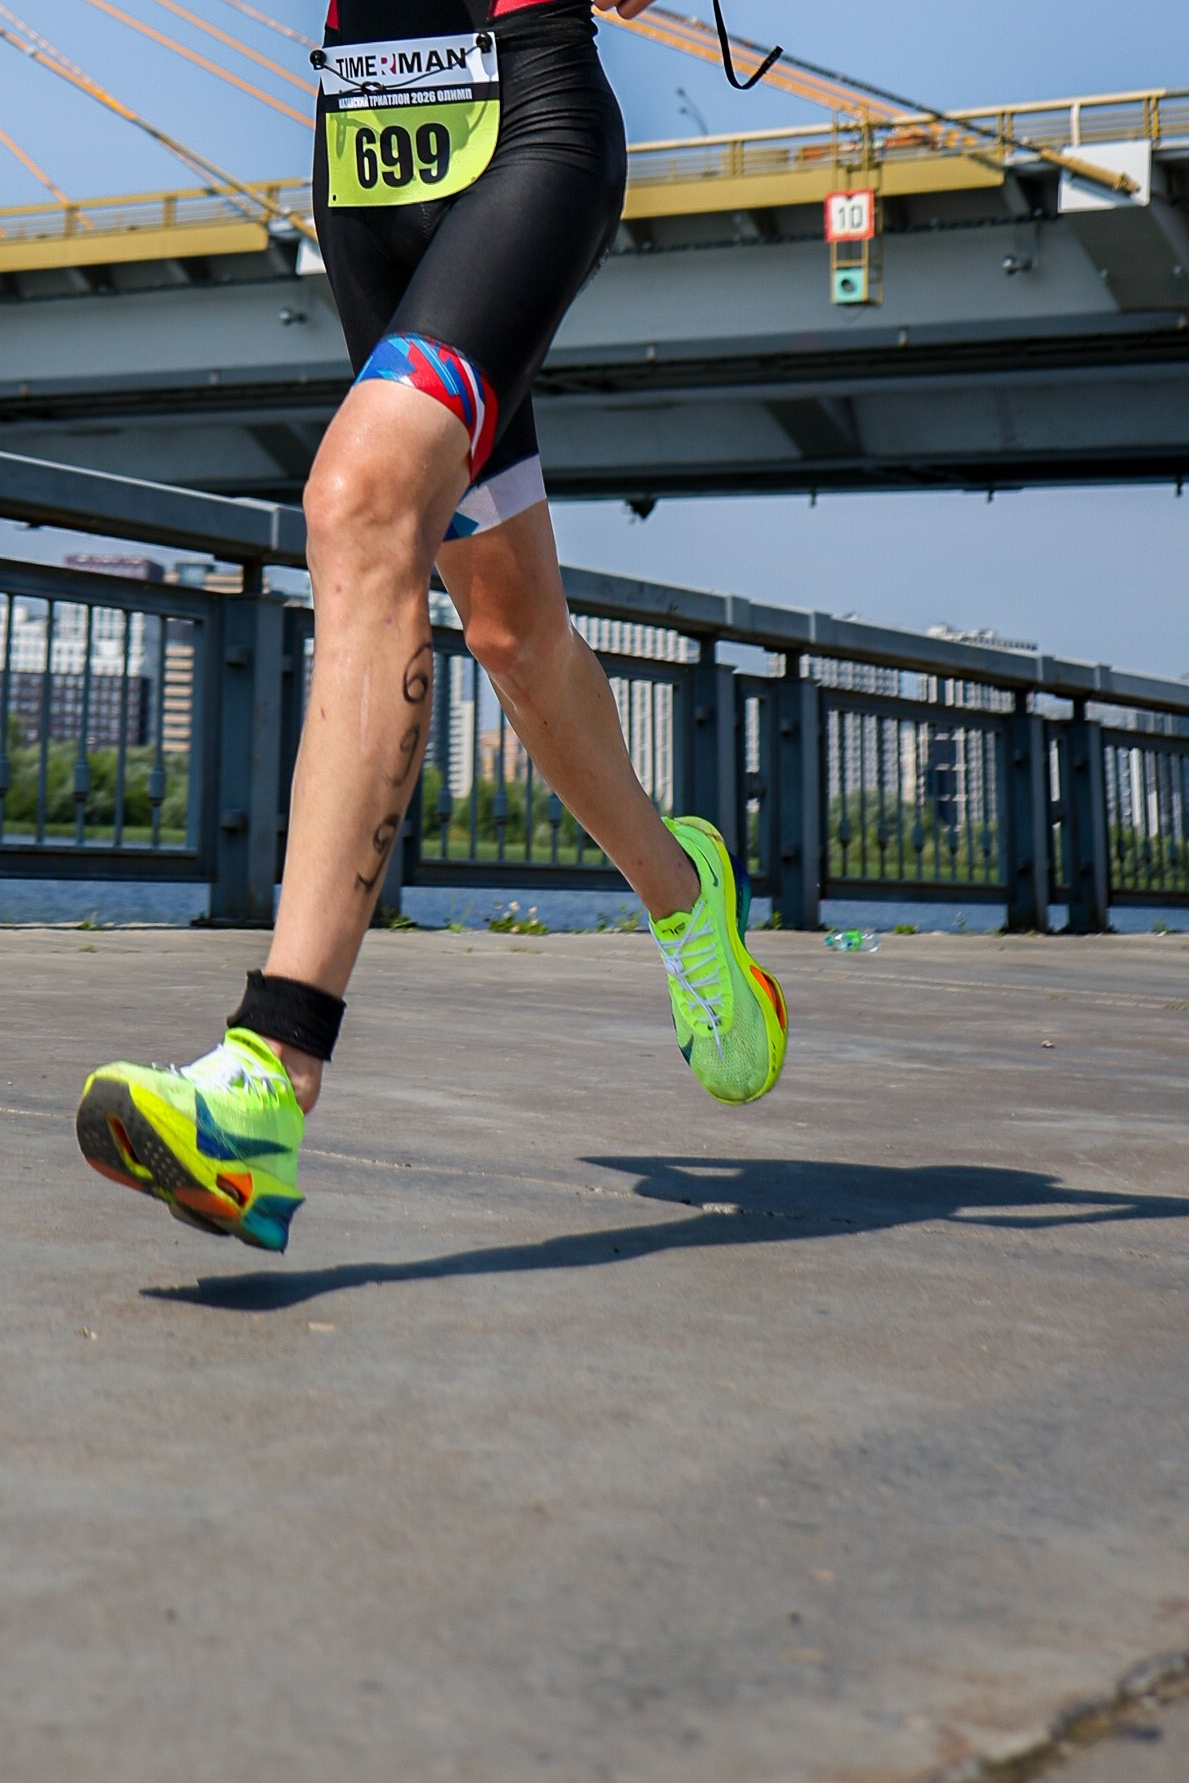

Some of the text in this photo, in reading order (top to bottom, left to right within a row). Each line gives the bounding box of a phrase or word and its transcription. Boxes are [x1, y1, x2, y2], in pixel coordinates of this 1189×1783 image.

[368, 92, 411, 107] ТРИАТЛОН
[411, 91, 436, 104] 2026
[436, 88, 473, 101] ОЛИМП
[355, 122, 451, 190] 699
[838, 205, 864, 229] 10
